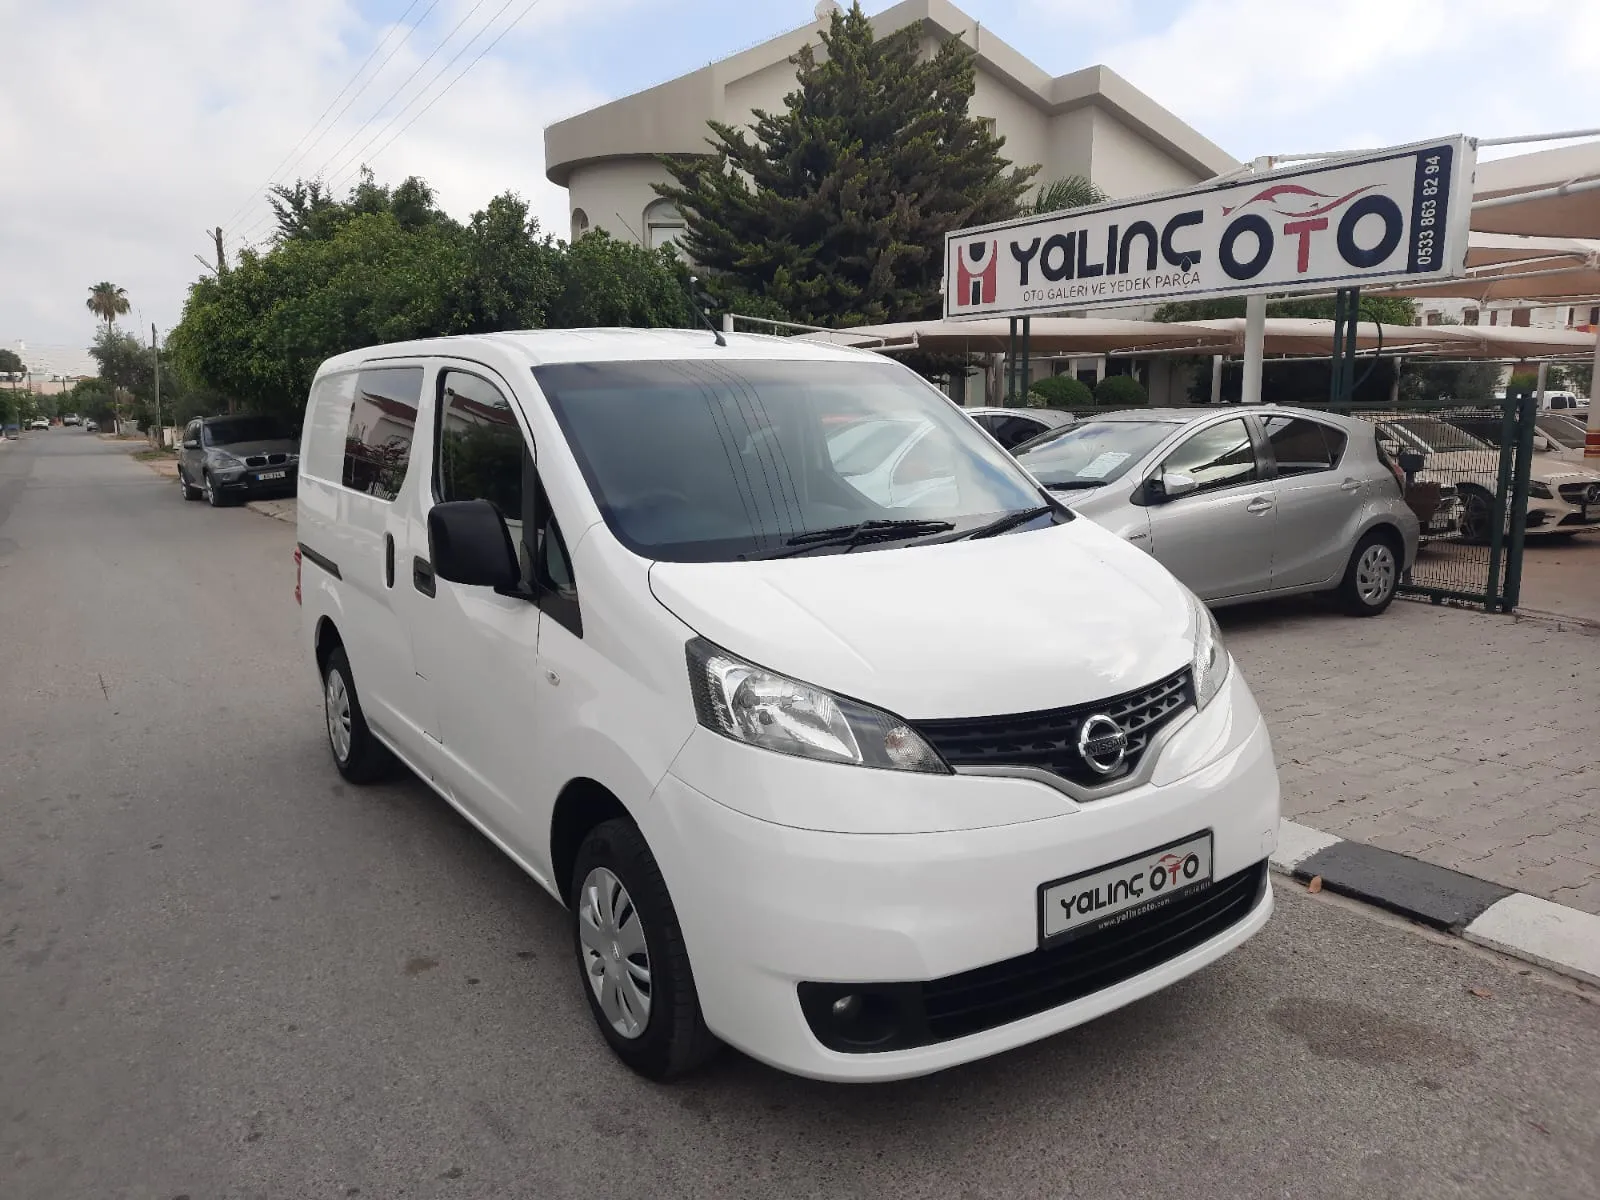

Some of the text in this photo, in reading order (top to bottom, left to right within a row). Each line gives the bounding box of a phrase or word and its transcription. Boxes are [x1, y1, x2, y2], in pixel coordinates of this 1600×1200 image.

[1219, 194, 1403, 280] OTO
[1417, 155, 1441, 265] 0533 863 82 94
[1023, 271, 1201, 302] OTO GALERİ VE YEDEK PARÇA
[1150, 853, 1199, 891] OTO
